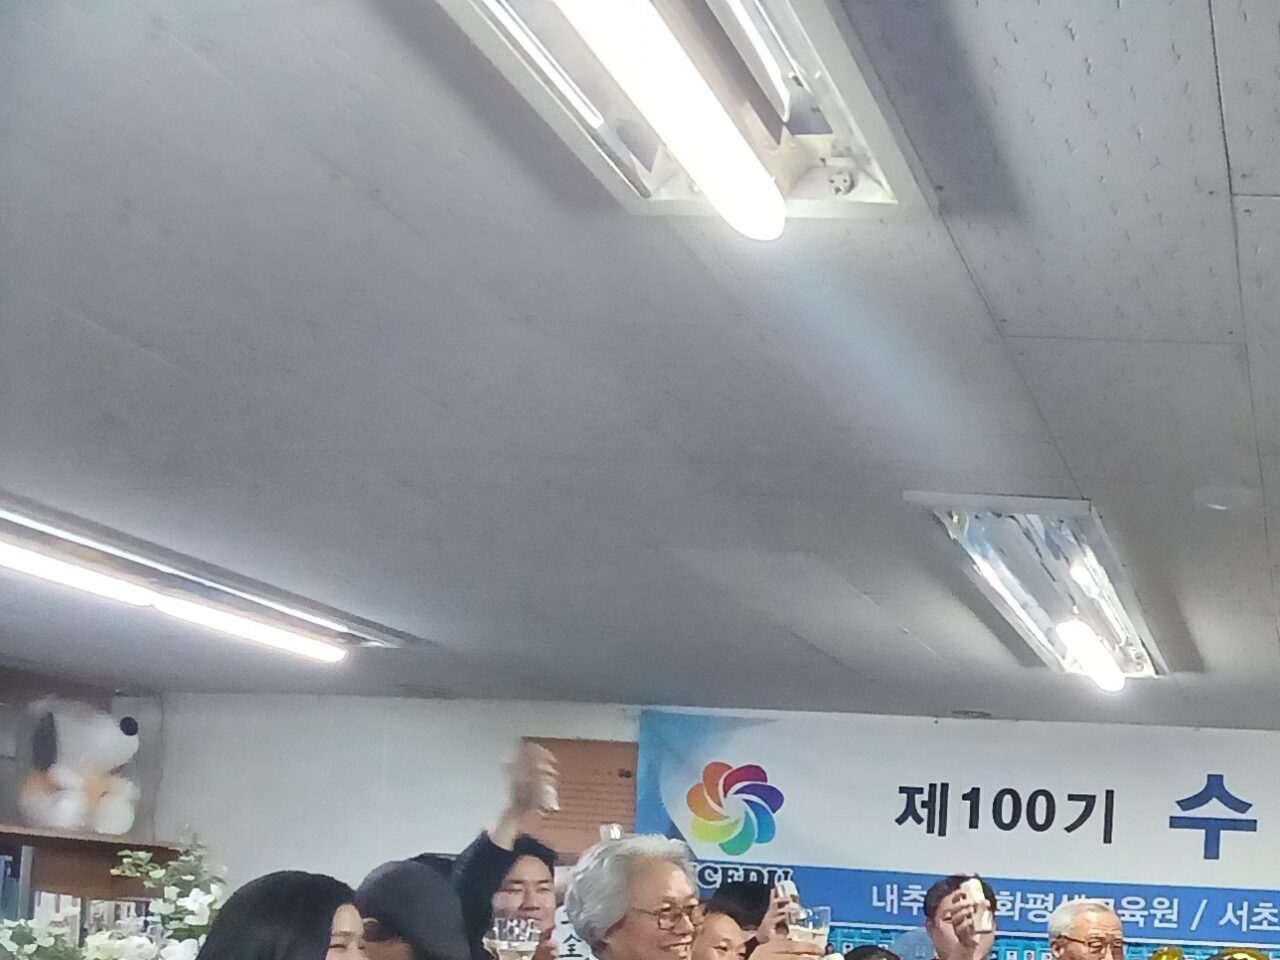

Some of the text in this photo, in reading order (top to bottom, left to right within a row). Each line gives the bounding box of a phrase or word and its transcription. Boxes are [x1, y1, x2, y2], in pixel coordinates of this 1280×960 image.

[895, 781, 1116, 844] 제100기
[694, 863, 793, 889] CEDU
[1218, 900, 1280, 934] 서초
